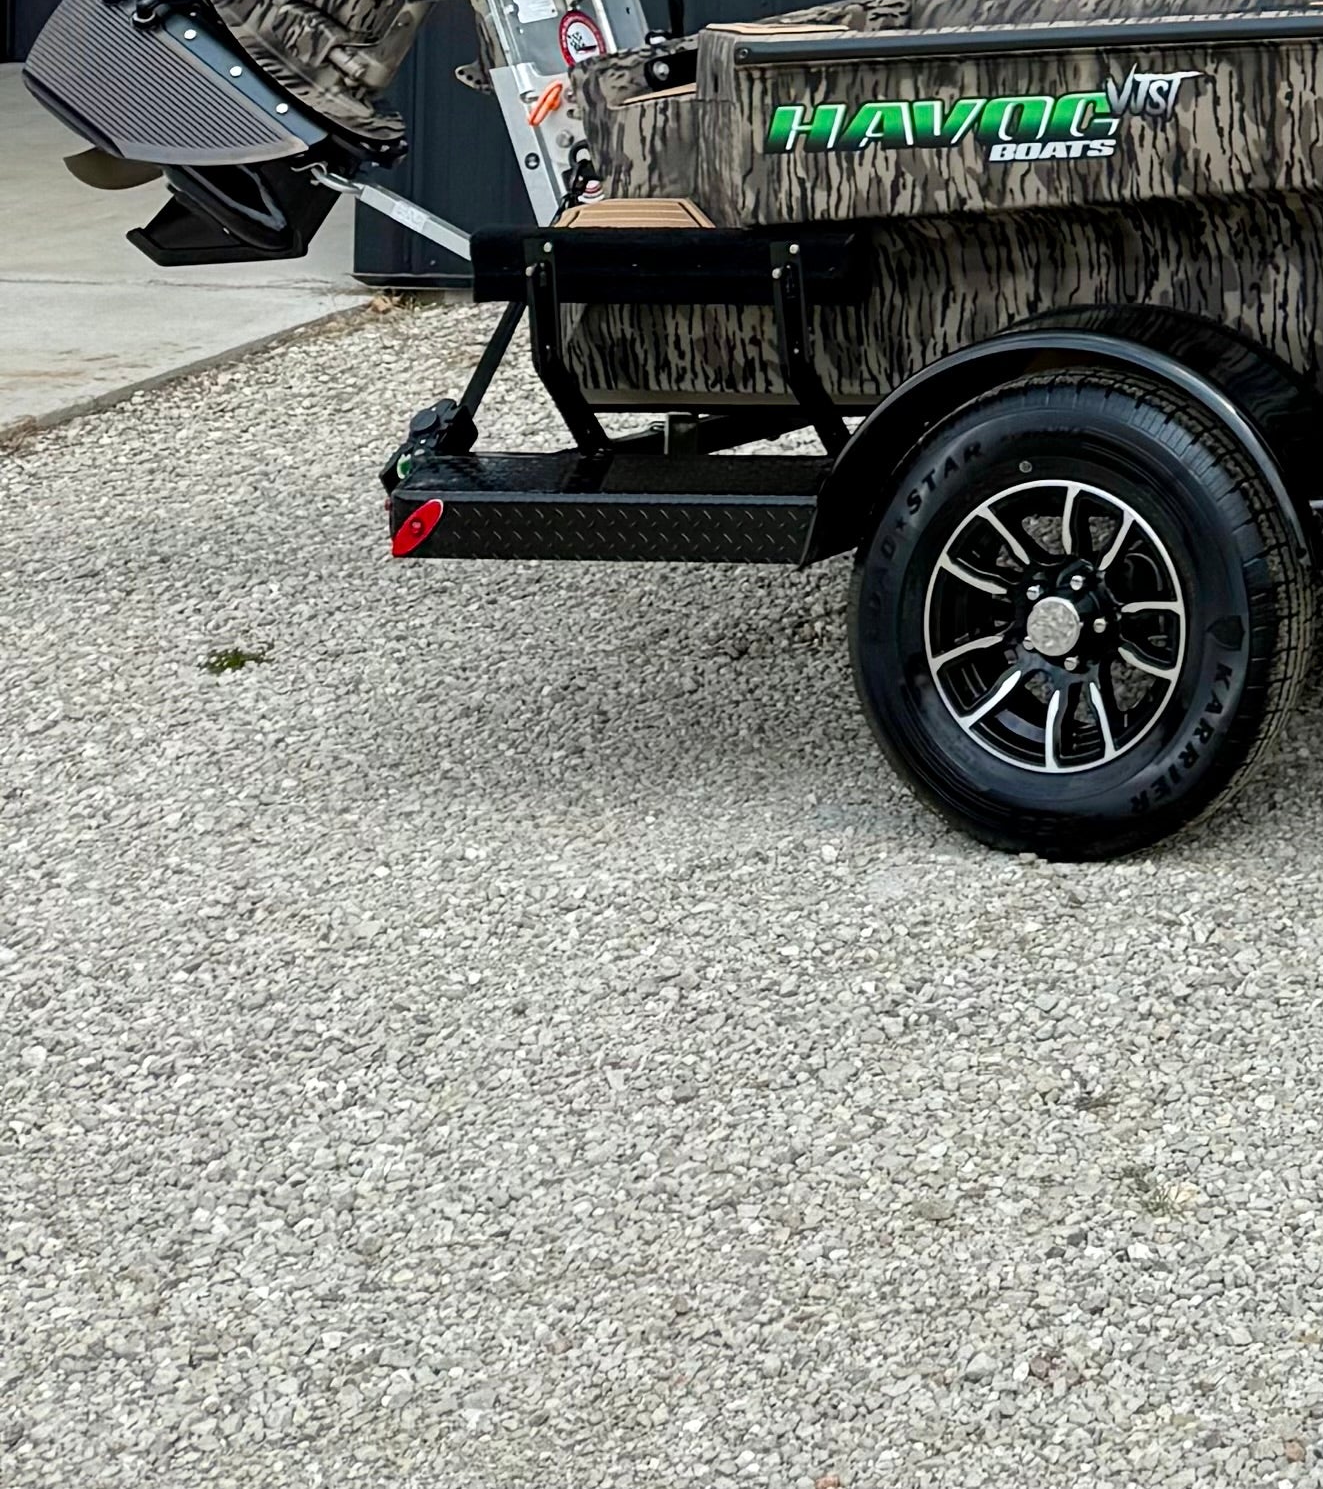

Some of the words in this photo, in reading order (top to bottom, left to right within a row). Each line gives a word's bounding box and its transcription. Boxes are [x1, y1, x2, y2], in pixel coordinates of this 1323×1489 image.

[765, 91, 1121, 155] HAVOC
[988, 138, 1118, 163] BOATS
[905, 441, 981, 516] STAR
[1130, 662, 1232, 815] KARRIER
